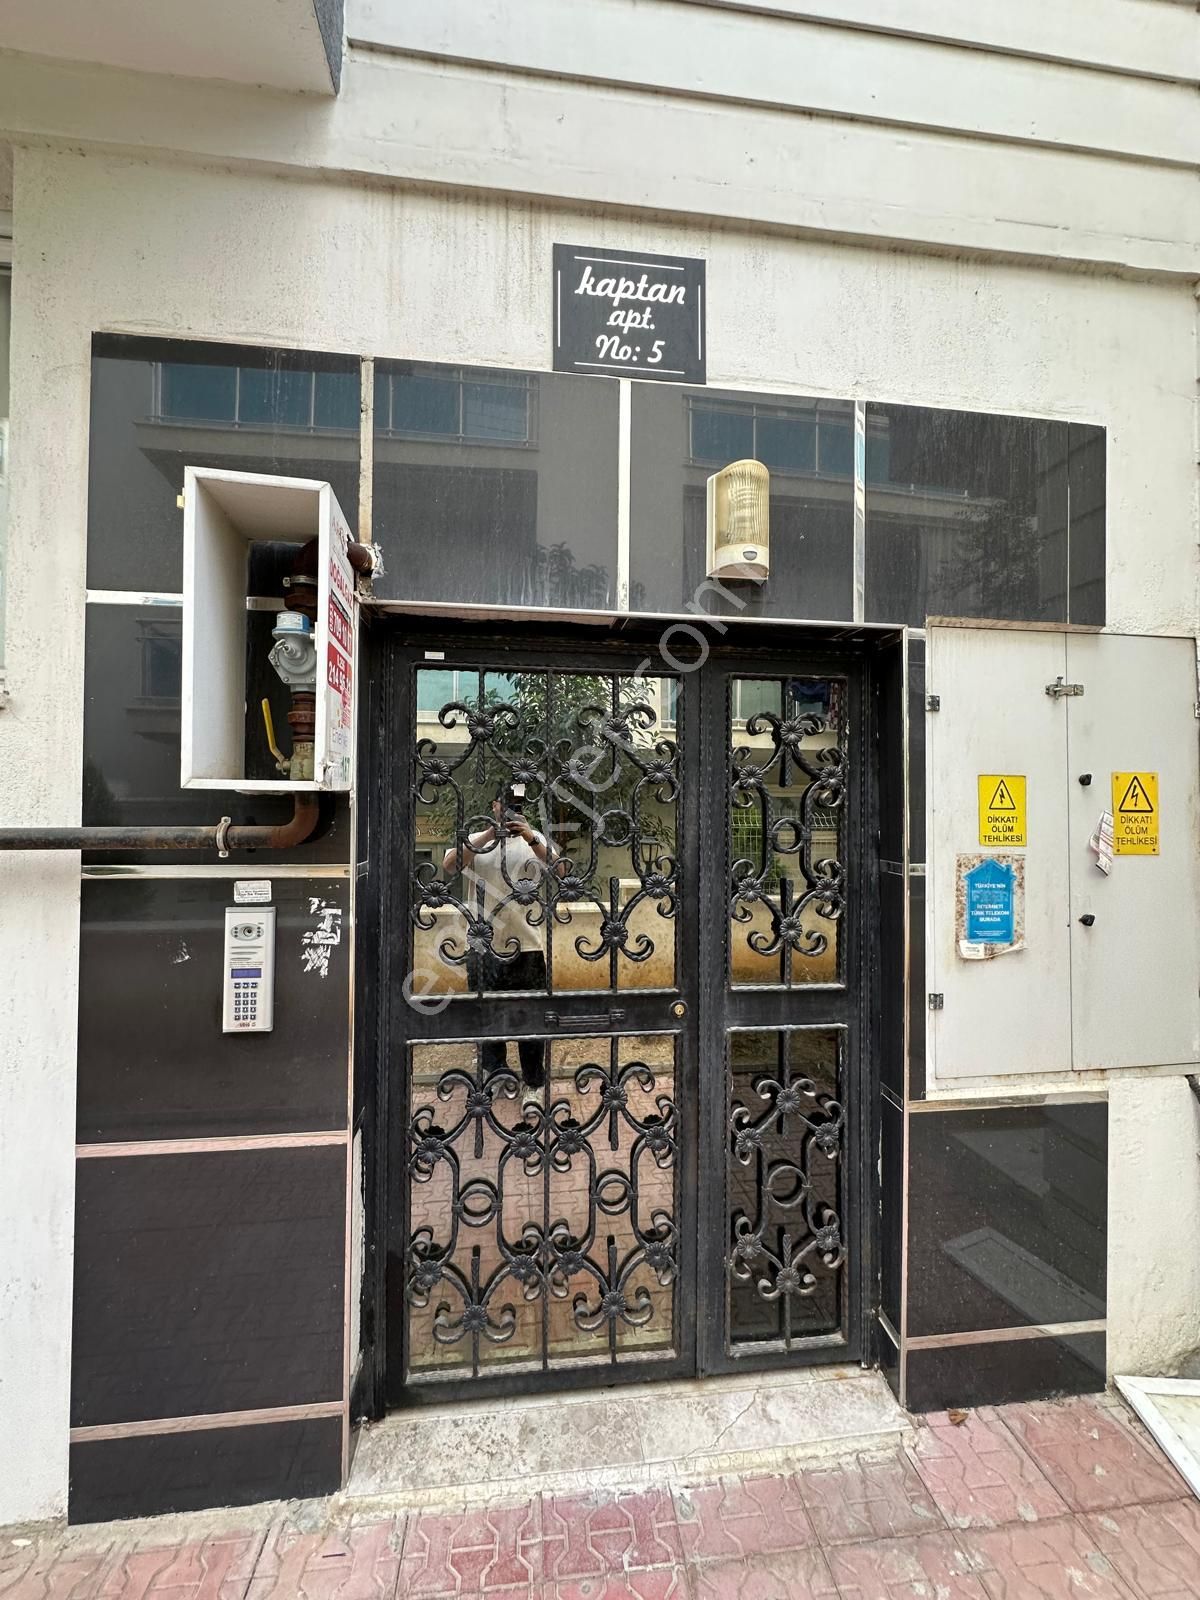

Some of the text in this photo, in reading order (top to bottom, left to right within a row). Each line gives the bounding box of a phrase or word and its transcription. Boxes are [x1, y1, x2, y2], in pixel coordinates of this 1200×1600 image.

[574, 265, 686, 307] kaptan
[606, 306, 655, 334] apt.
[595, 334, 666, 363] No: 5
[991, 824, 1014, 833] ÖLÜM
[1124, 825, 1148, 835] ÖLÜM
[983, 834, 1023, 843] TEHLİKESİ
[1116, 836, 1158, 846] TEHLİKESİ
